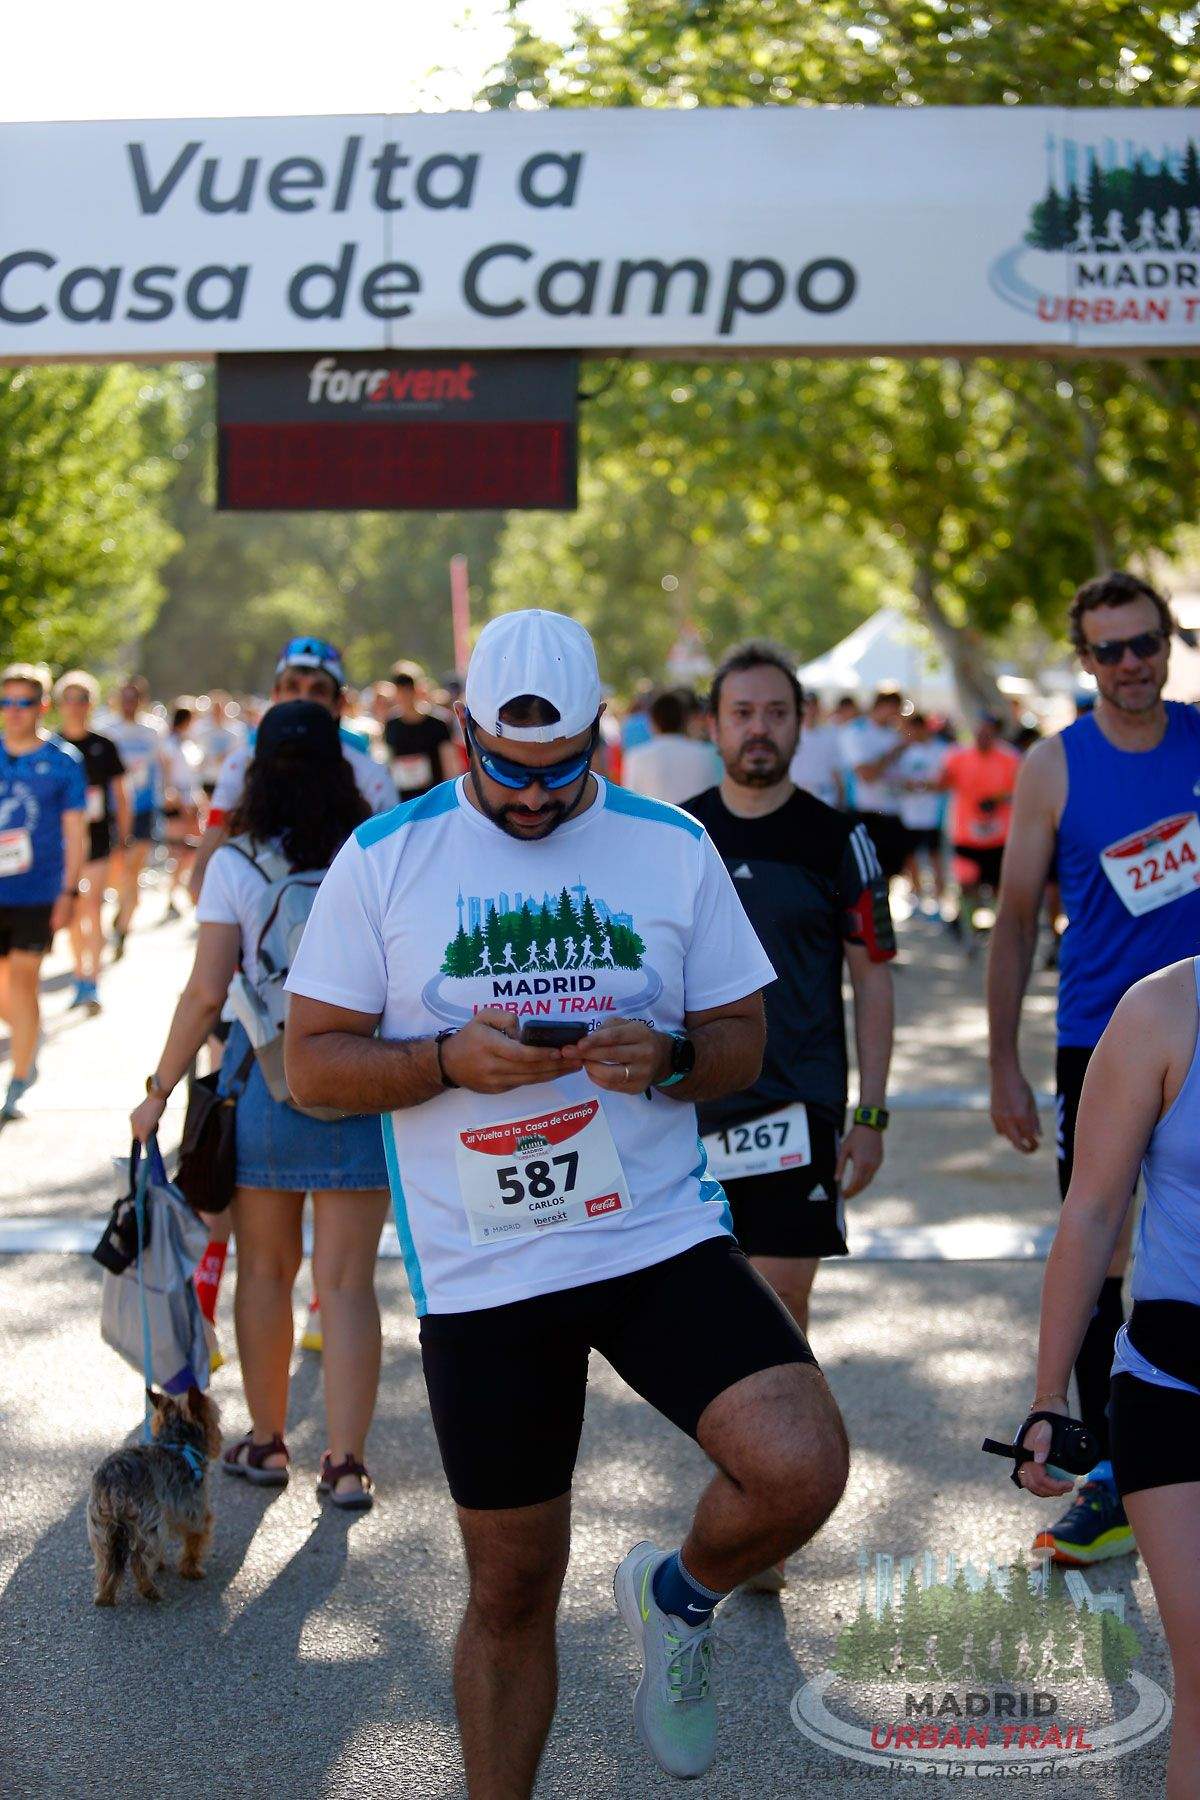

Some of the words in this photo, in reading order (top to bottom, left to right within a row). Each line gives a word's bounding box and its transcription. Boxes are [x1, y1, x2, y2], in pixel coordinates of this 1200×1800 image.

[126, 135, 482, 216] Vuelta
[519, 150, 585, 209] a
[0, 249, 251, 325] Casa
[286, 242, 422, 322] de
[462, 242, 858, 336] Campo
[1037, 295, 1170, 324] URBAN
[1127, 841, 1197, 891] 2244
[493, 975, 596, 998] MADRID
[558, 996, 617, 1013] TRAIL
[476, 1131, 503, 1142] Vuelta
[504, 1128, 511, 1137] a
[512, 1126, 521, 1135] la
[525, 1121, 549, 1132] Casa
[550, 1115, 561, 1126] de
[562, 1107, 594, 1121] Campo
[718, 1122, 789, 1154] 1267
[522, 1147, 544, 1156] MADRID
[496, 1150, 579, 1205] 587
[528, 1196, 565, 1211] CARLOS
[492, 1223, 521, 1234] MADRID
